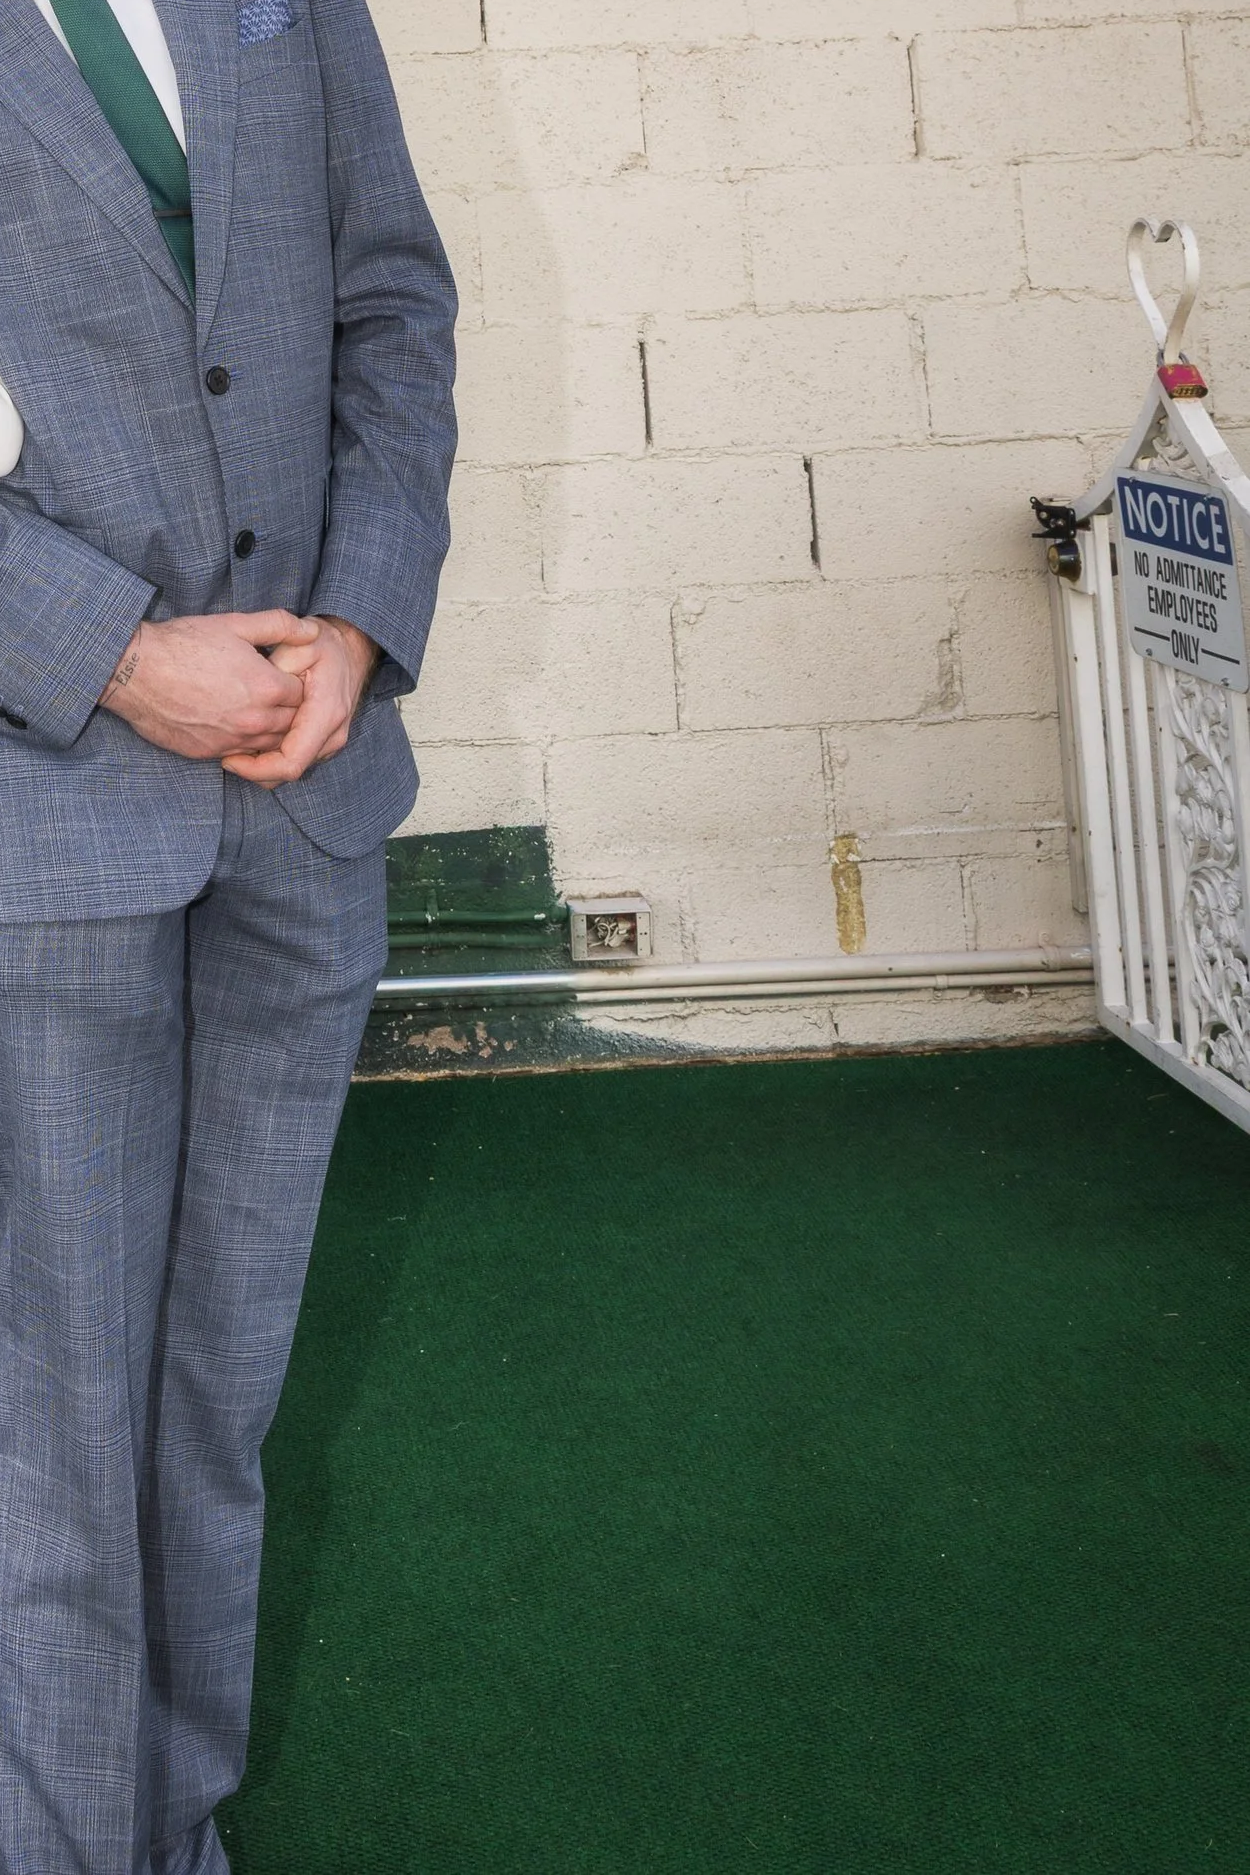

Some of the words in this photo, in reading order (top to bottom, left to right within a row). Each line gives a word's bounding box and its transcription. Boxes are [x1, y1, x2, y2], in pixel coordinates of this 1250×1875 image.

[1124, 485, 1226, 554] NOTICE
[1134, 550, 1150, 578] NO
[1156, 556, 1227, 600] ADMITTANCE
[1147, 585, 1218, 633] EMPLOYEES
[114, 651, 141, 687] Elsie
[1171, 629, 1199, 665] ONLY
